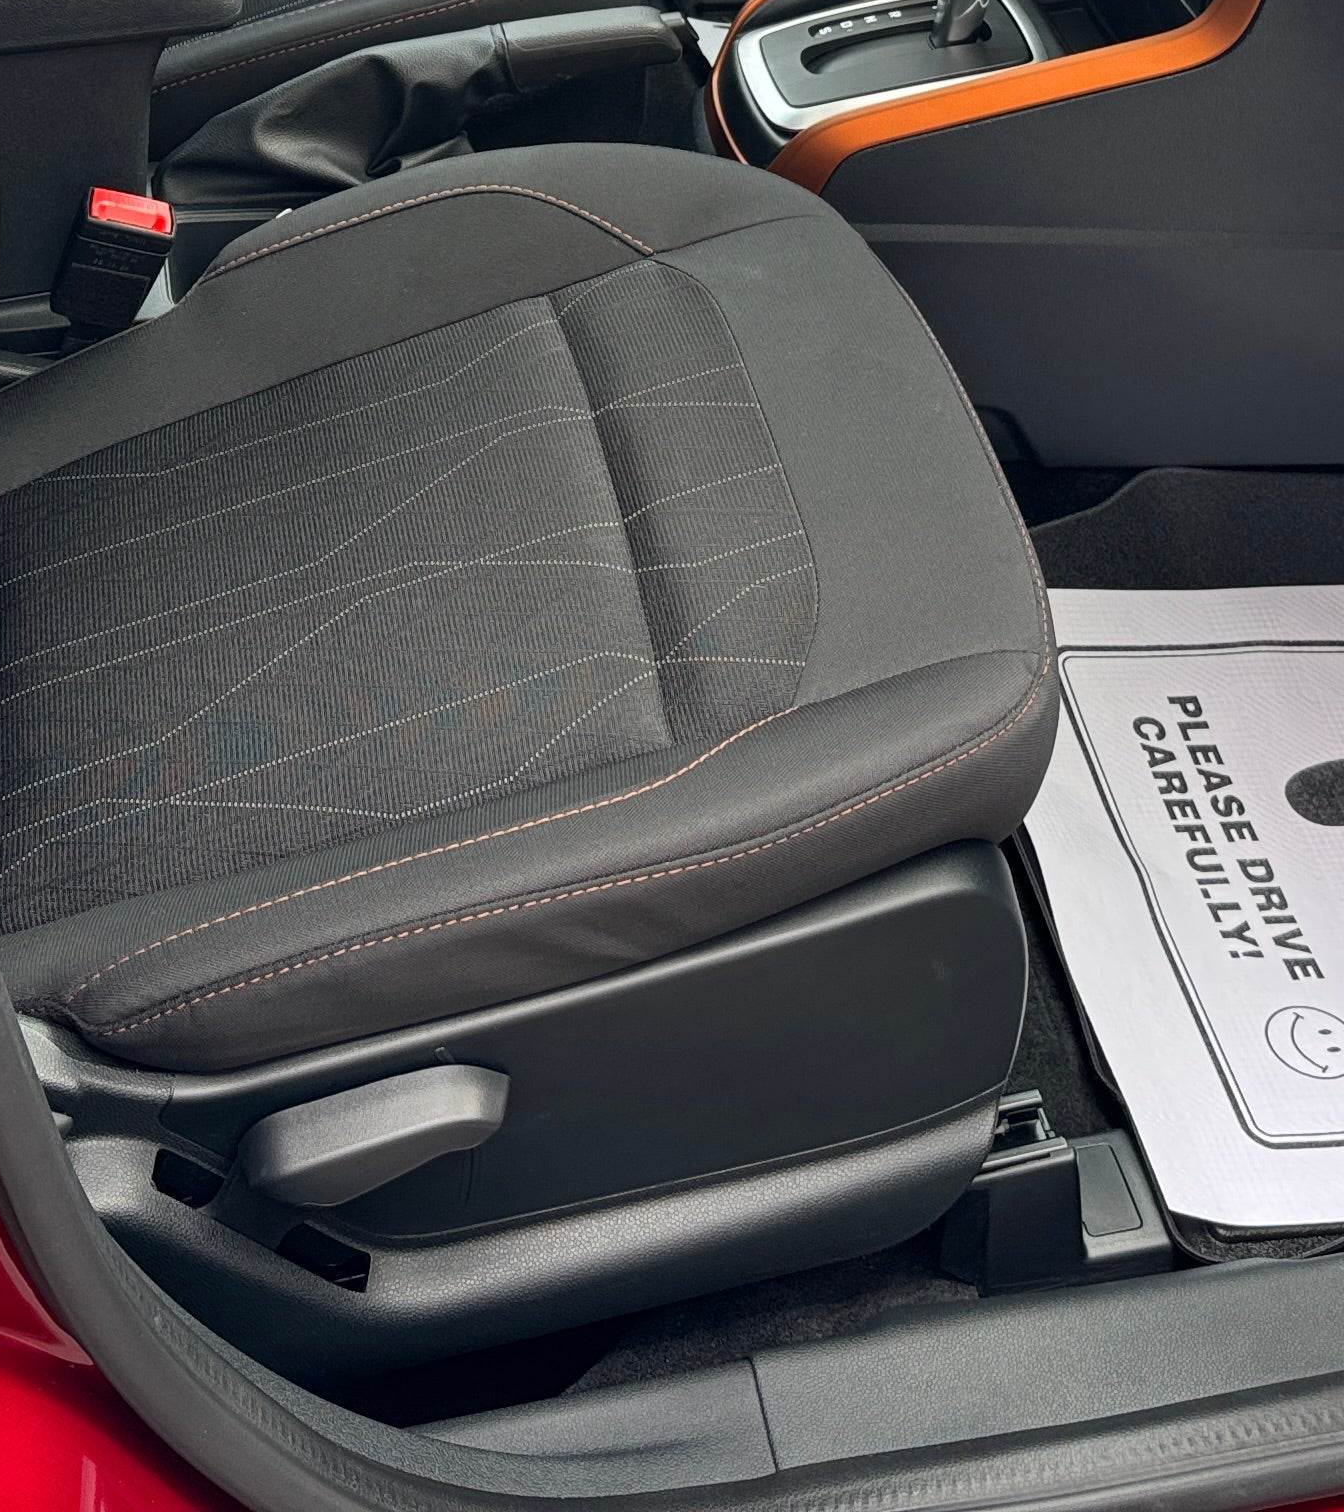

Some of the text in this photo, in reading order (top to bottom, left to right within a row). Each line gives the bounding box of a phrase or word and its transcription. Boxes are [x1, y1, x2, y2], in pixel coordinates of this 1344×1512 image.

[1132, 715, 1265, 959] CAREFULLY!
[1166, 694, 1326, 981] PLEASE DRIVE
